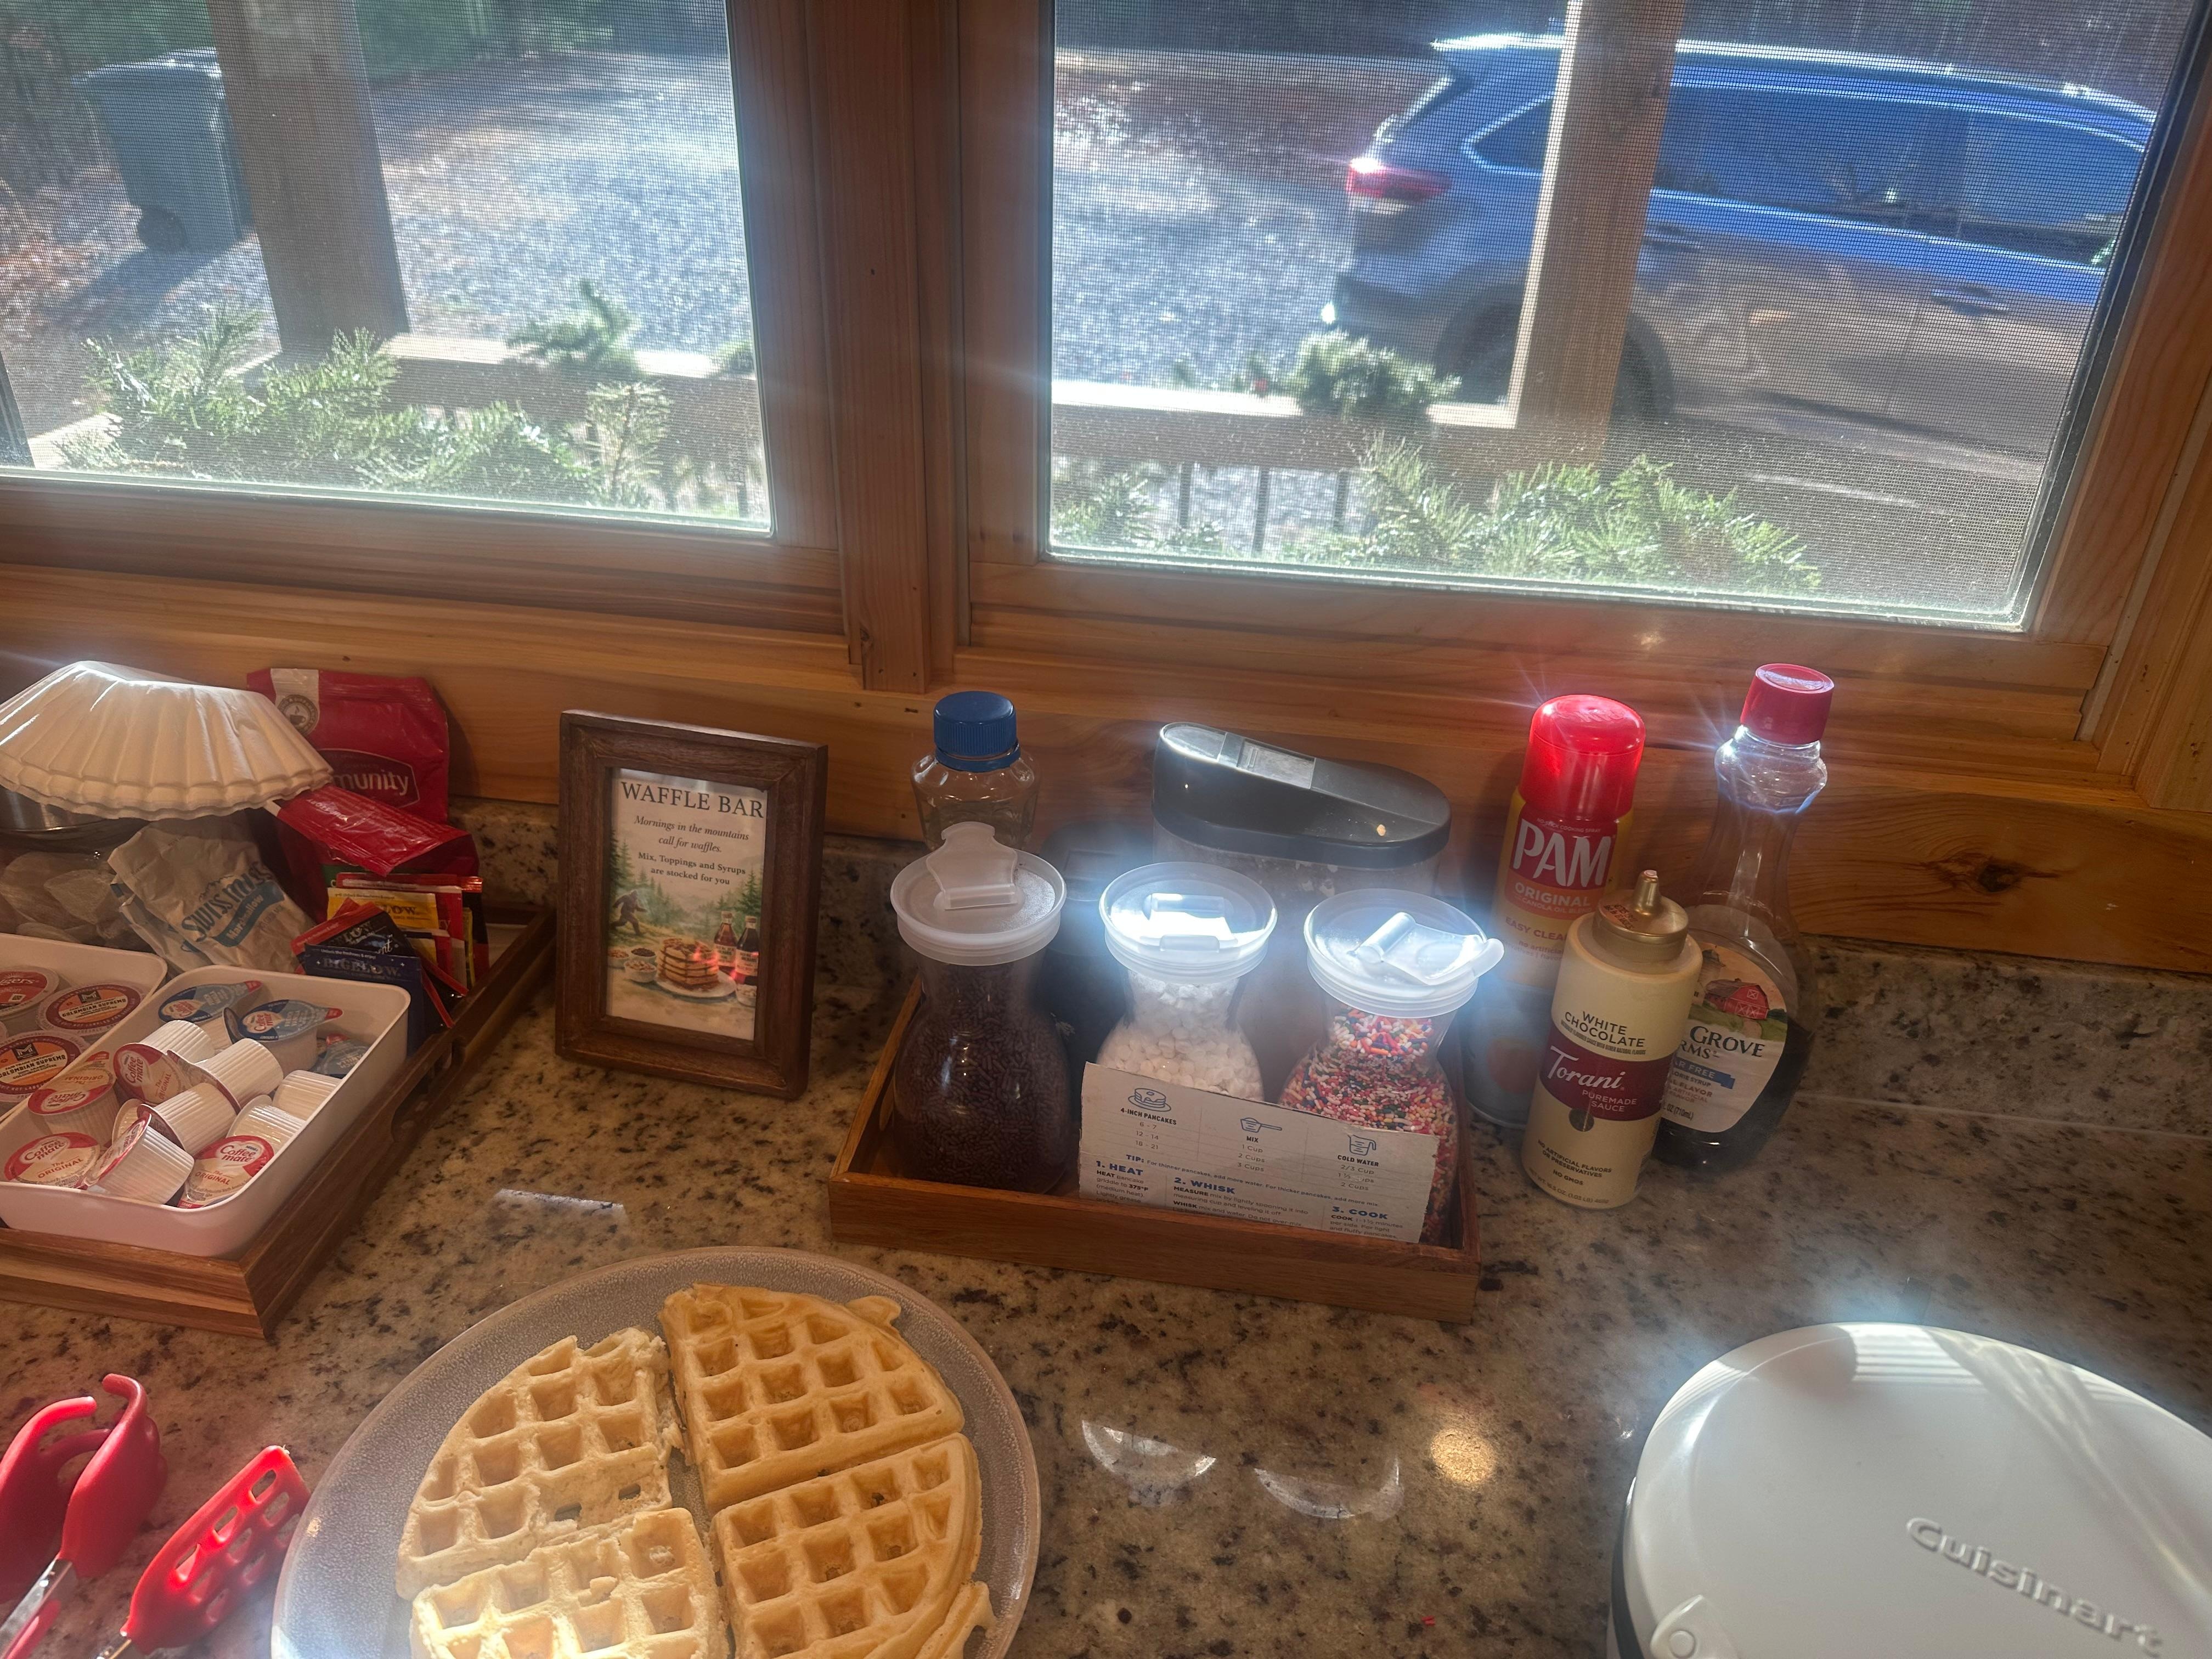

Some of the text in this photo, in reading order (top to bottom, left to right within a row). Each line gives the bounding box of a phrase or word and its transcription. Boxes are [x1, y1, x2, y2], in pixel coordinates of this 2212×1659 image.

[333, 769, 408, 796] munity
[621, 782, 764, 818] WAFFLE BAR
[634, 815, 675, 831] Mornings
[689, 824, 702, 833] the
[704, 828, 749, 840] mountains
[1560, 825, 1584, 833] COOKING
[659, 836, 721, 853] call for waffles.
[1513, 818, 1612, 888] PAM
[638, 852, 657, 862] Mix,
[659, 855, 697, 868] Toppings
[718, 864, 746, 874] Syrups
[667, 871, 698, 880] stocked
[1515, 882, 1591, 907] ORIGINAL
[1522, 898, 1552, 911] CANOLA
[1506, 916, 1532, 933] EASY
[62, 998, 127, 1017] COLOMBIAN SUPREMO
[1565, 1012, 1645, 1047] CHOCOLATE
[1583, 1011, 1627, 1035] WHITE
[1680, 1040, 1711, 1059] RMS
[1690, 1025, 1765, 1057] GROVE
[36, 1054, 66, 1066] SUPREMO
[1547, 1045, 1626, 1089] Torani
[126, 1056, 137, 1084] Coffee
[136, 1058, 144, 1082] mate
[1689, 1062, 1717, 1079] FREE
[1679, 1082, 1713, 1098] FLAVOR
[1690, 1076, 1712, 1087] SYRUP
[1582, 1089, 1638, 1105] PUREMADE
[1591, 1101, 1626, 1112] SAUCE
[1120, 1107, 1177, 1125] 4-INCH PANCAKES
[24, 1140, 61, 1161] Coffee
[37, 1141, 66, 1160] mate
[220, 1145, 257, 1158] Coffee
[1247, 1146, 1263, 1154] Cup
[1538, 1139, 1612, 1173] NO ARTIFICIAL FLAVORS
[1245, 1154, 1266, 1164] Cups
[1337, 1154, 1379, 1167] COLD WATER
[1542, 1150, 1550, 1159] OR
[1551, 1156, 1602, 1178] PRESERVATIVES
[38, 1158, 83, 1178] ORIGINAL
[1096, 1160, 1144, 1176] 1. HEAT
[1126, 1154, 1145, 1164] TIP:
[1158, 1162, 1181, 1171] thinner
[1277, 1186, 1300, 1194] thicker
[1244, 1164, 1265, 1173] Cups
[1358, 1167, 1374, 1176] Cup
[195, 1171, 232, 1185] ORIGINAL
[1097, 1170, 1144, 1185] HEAT pancake
[1097, 1177, 1120, 1187] griddle
[1174, 1176, 1236, 1195] 2. WHISK
[1553, 1169, 1584, 1186] NO GMOS
[1097, 1183, 1125, 1194] (medium
[1348, 1183, 1369, 1191] Cups
[1096, 1190, 1119, 1200] Lightly
[1119, 1195, 1142, 1204] grease
[1173, 1186, 1209, 1197] MEASURE
[1233, 1197, 1254, 1206] lightly
[1255, 1201, 1288, 1212] spooning
[1173, 1193, 1208, 1204] measuring
[1237, 1203, 1264, 1214] leveling
[1173, 1200, 1198, 1209] WHISK
[1349, 1209, 1388, 1220] COOK
[1344, 1227, 1363, 1235] fluffy
[1374, 1225, 1391, 1233] light
[1375, 1220, 1403, 1229] minutes
[1906, 1517, 2163, 1658] Cuisinart
